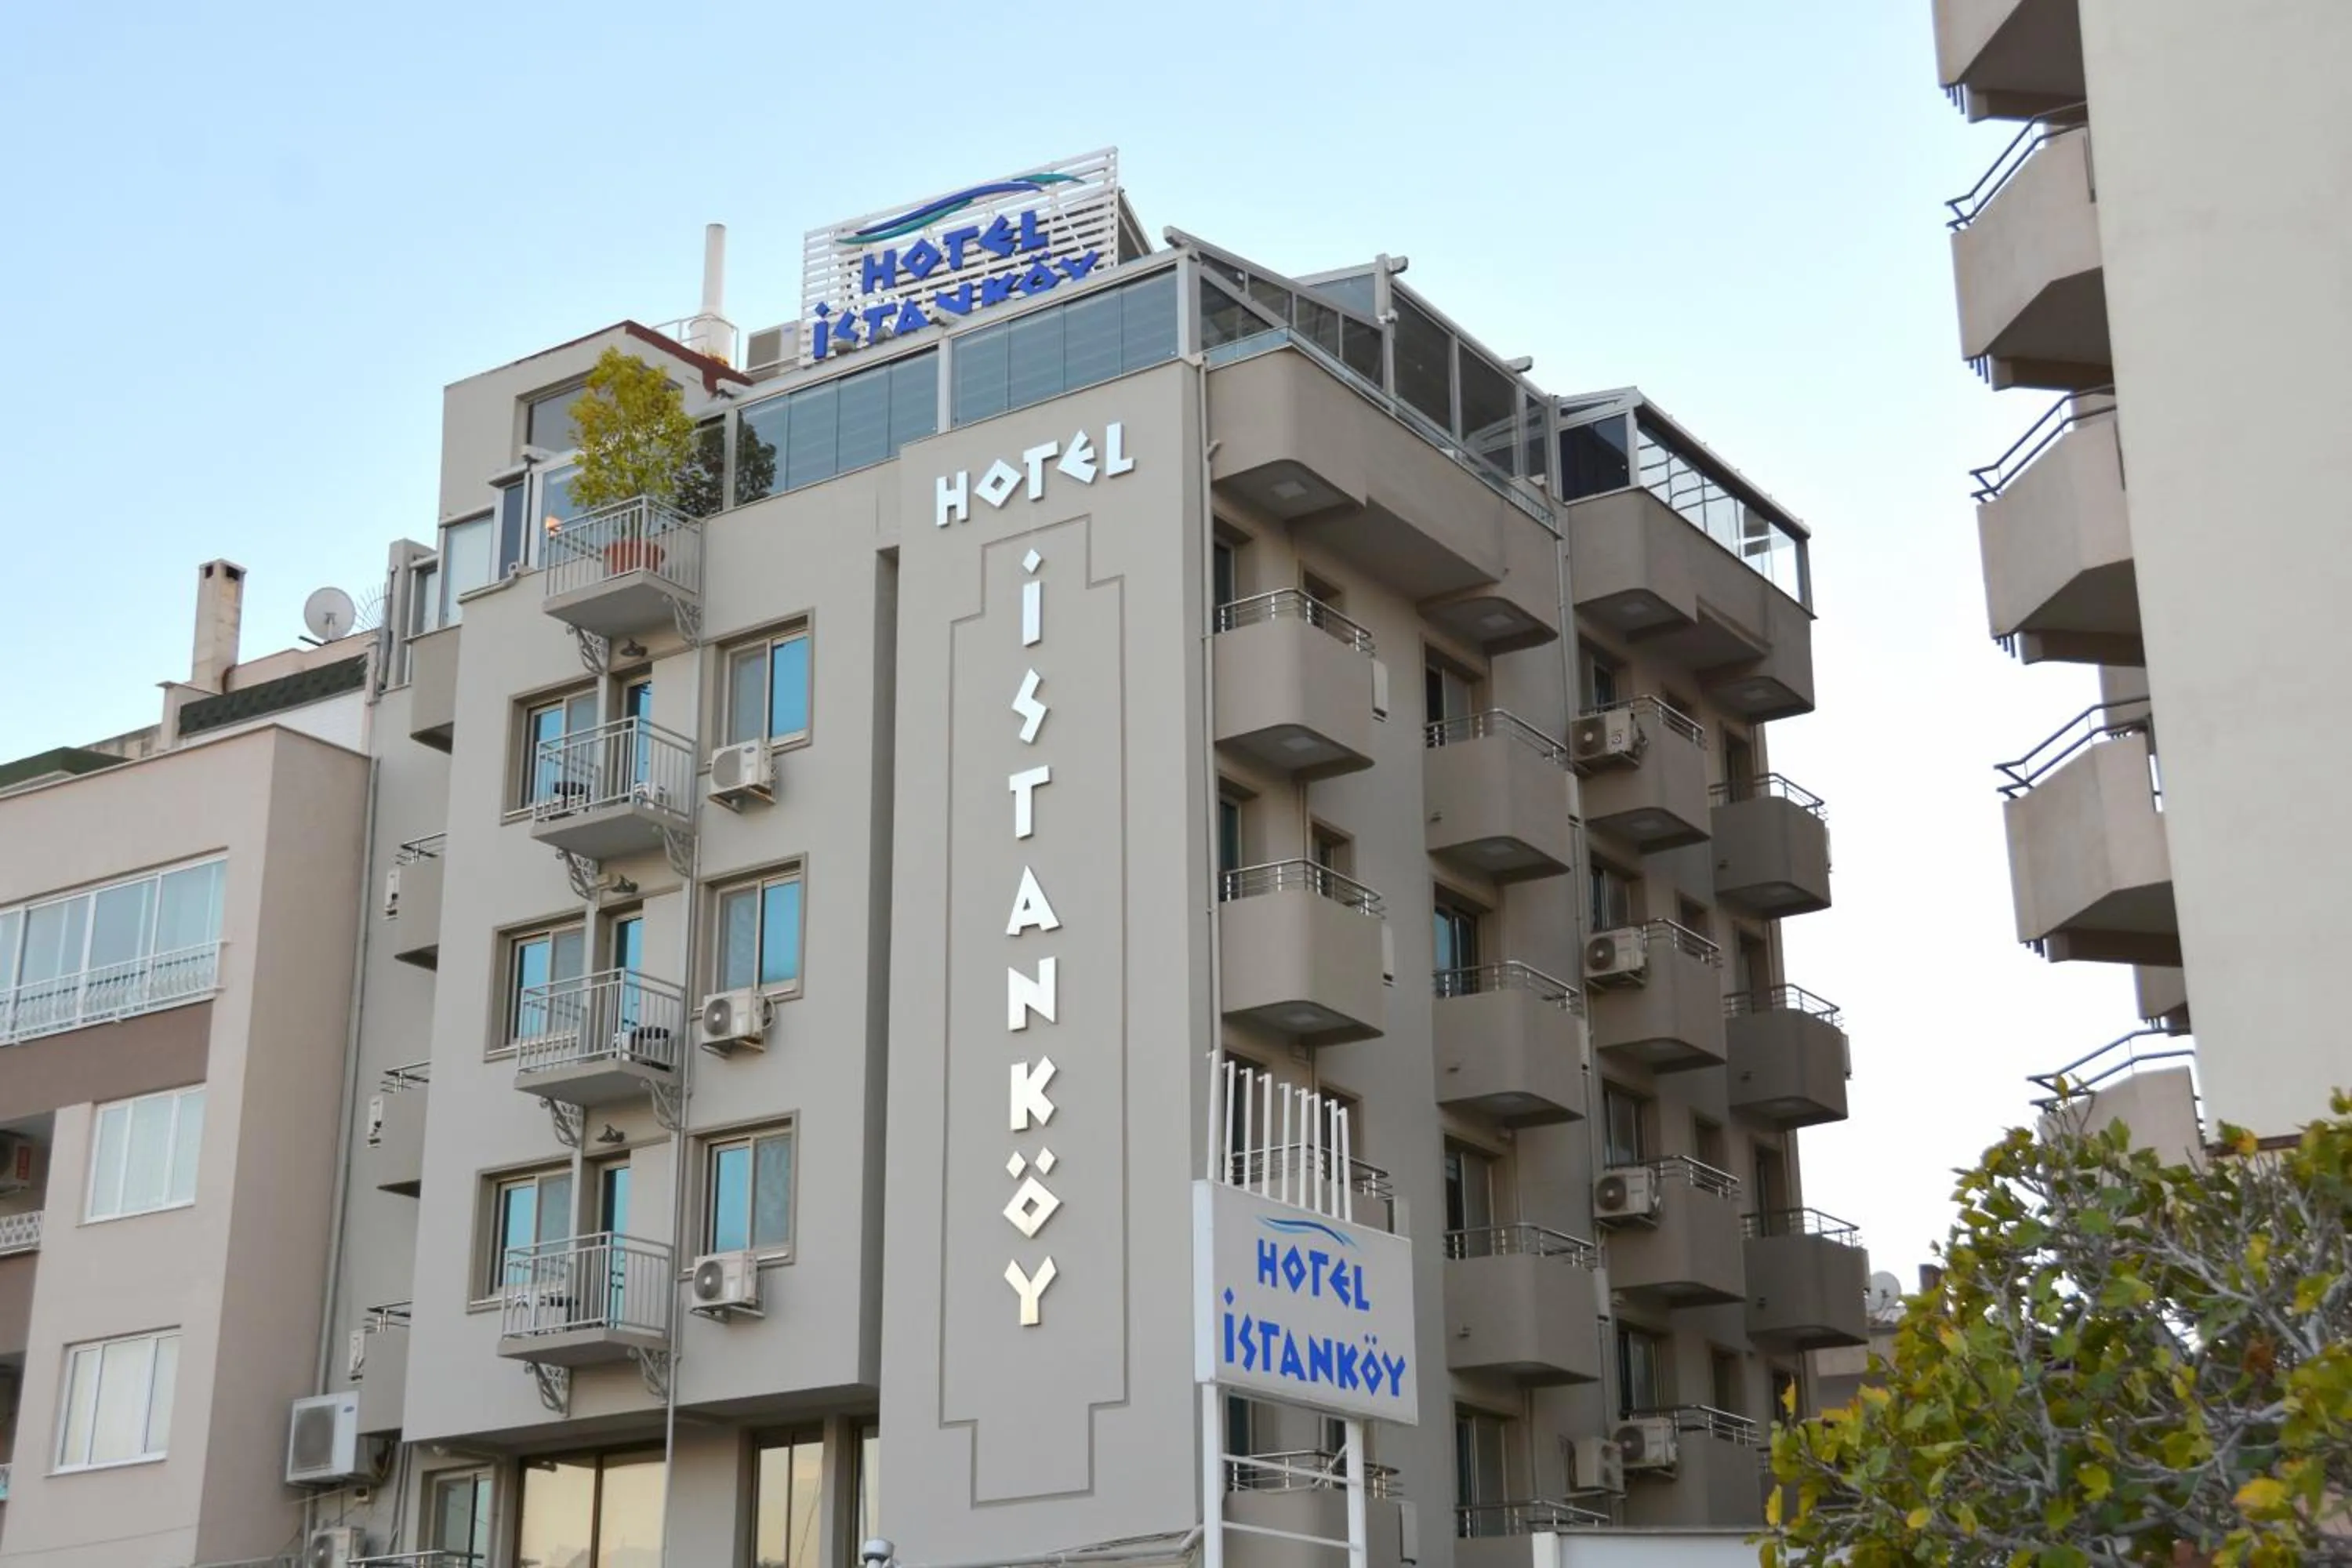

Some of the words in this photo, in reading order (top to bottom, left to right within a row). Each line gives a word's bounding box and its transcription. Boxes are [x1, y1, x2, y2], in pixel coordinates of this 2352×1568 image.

[862, 209, 1049, 294] HOTEL
[936, 421, 1135, 527] HOTEL
[1258, 1238, 1370, 1312] HOTEL
[1223, 1287, 1406, 1396] İSTANKÖY
